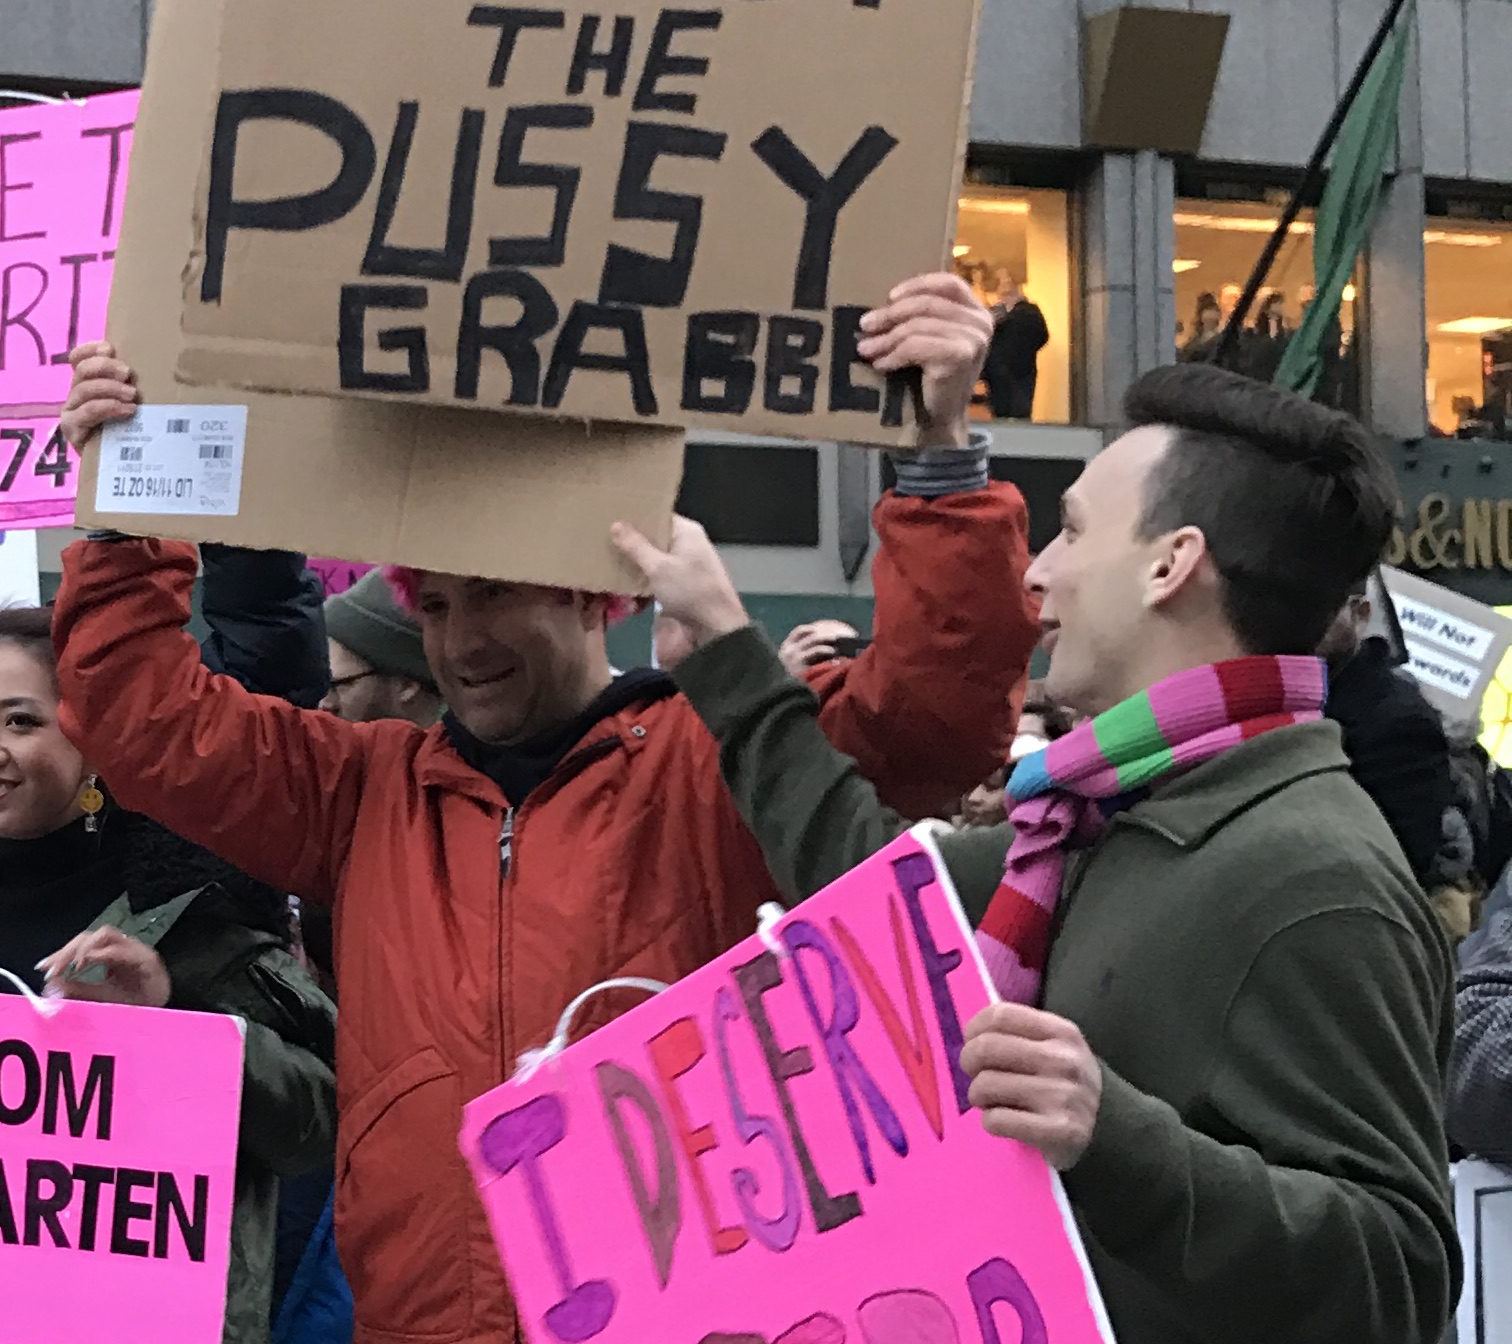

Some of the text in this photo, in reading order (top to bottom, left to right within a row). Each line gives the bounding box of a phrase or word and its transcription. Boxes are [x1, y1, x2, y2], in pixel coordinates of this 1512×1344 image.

[467, 6, 722, 114] THE
[199, 87, 899, 310] PUSSY
[478, 853, 976, 1344] I DESERVE
